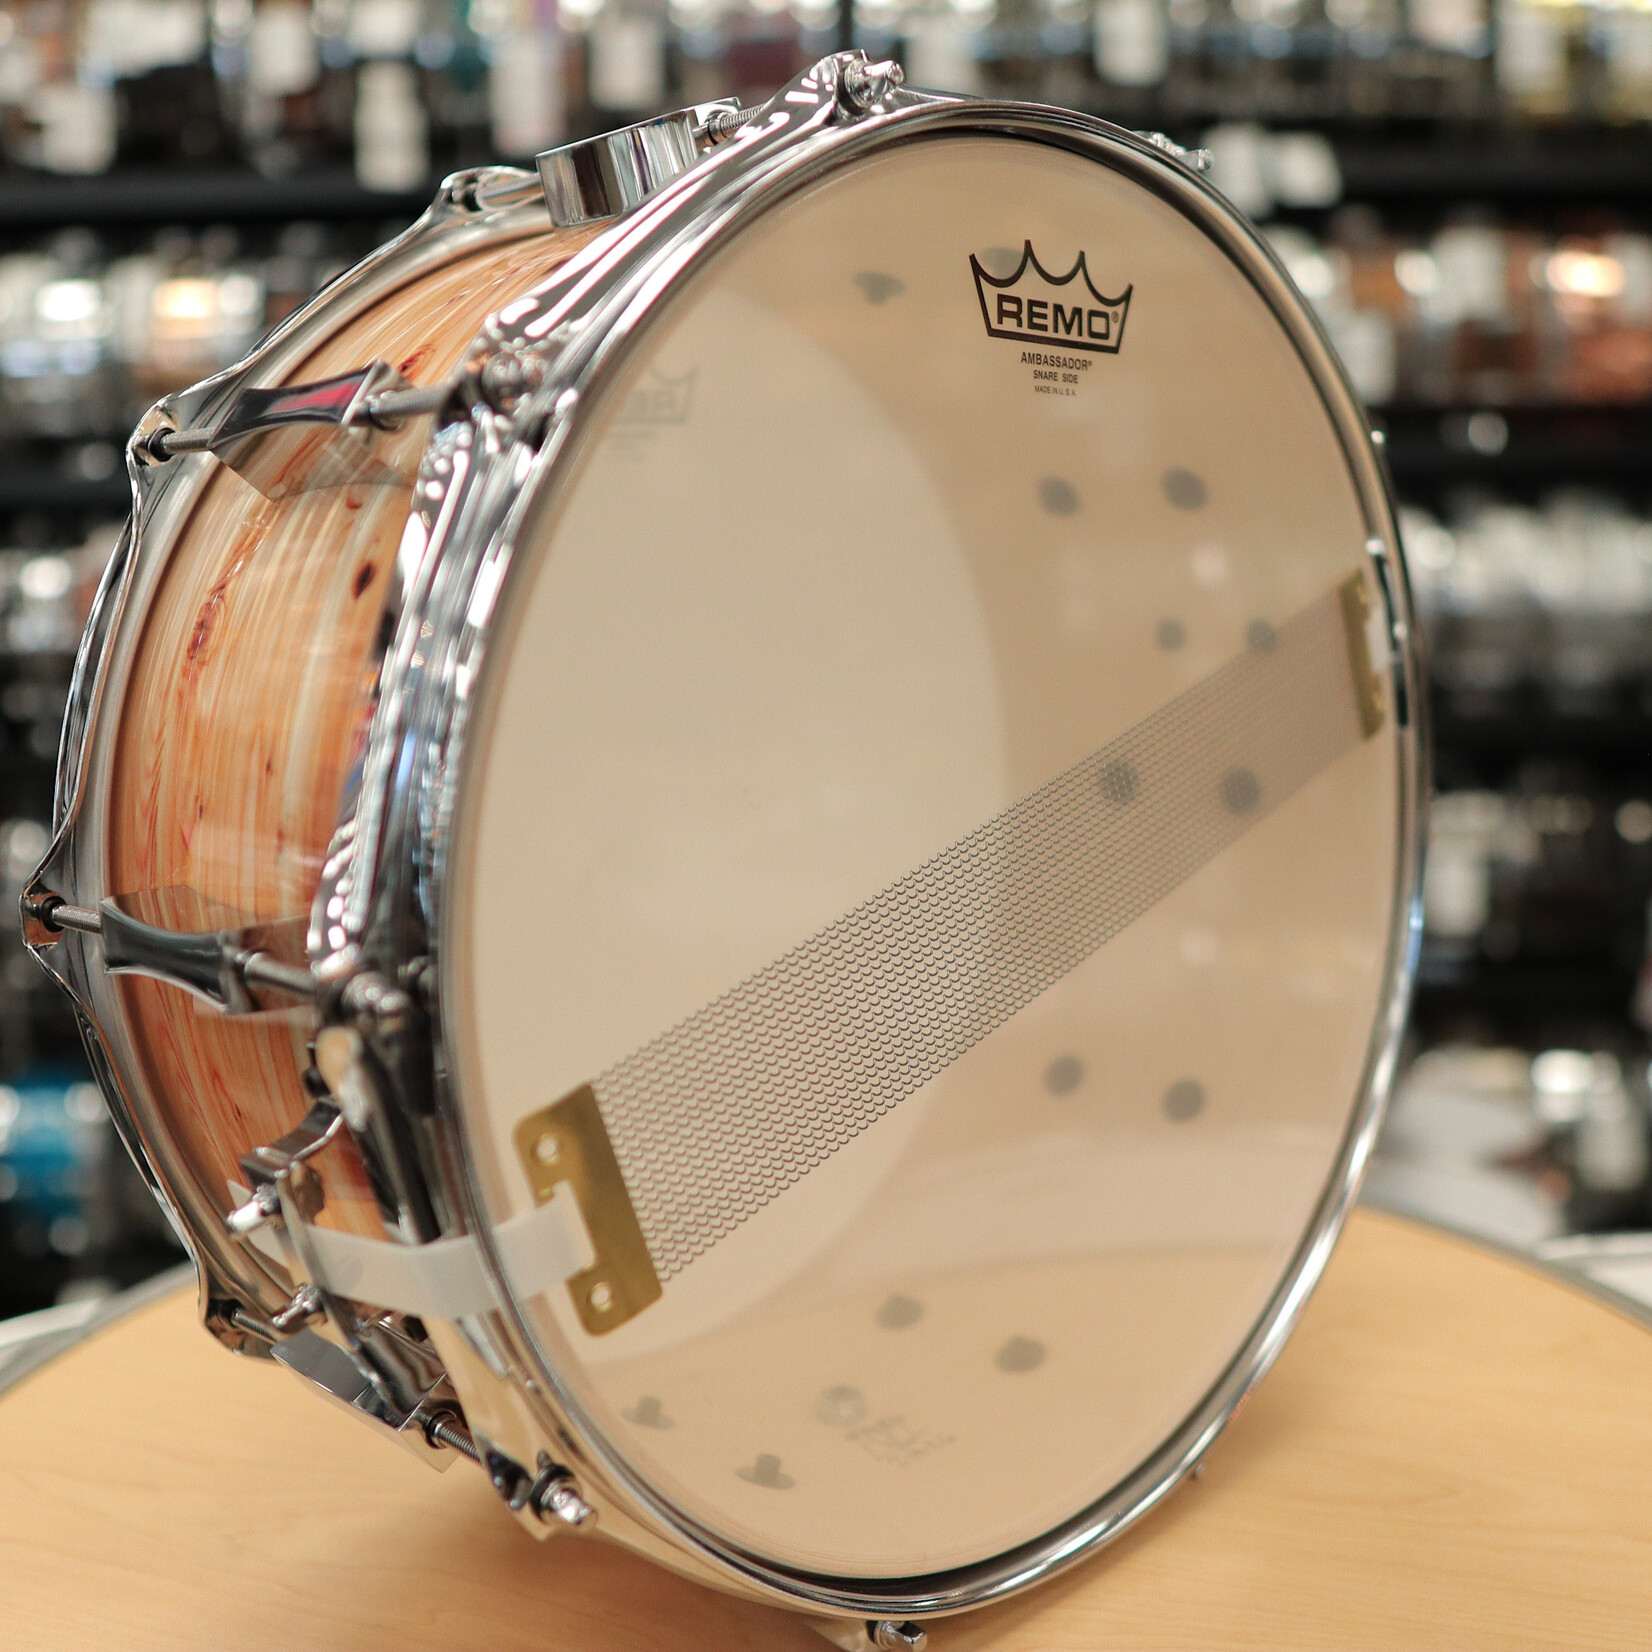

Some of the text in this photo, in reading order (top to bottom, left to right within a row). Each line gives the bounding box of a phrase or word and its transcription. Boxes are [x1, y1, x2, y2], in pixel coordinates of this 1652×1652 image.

[1033, 369, 1078, 384] SNARE SIDE
[1034, 385, 1051, 394] MADE
